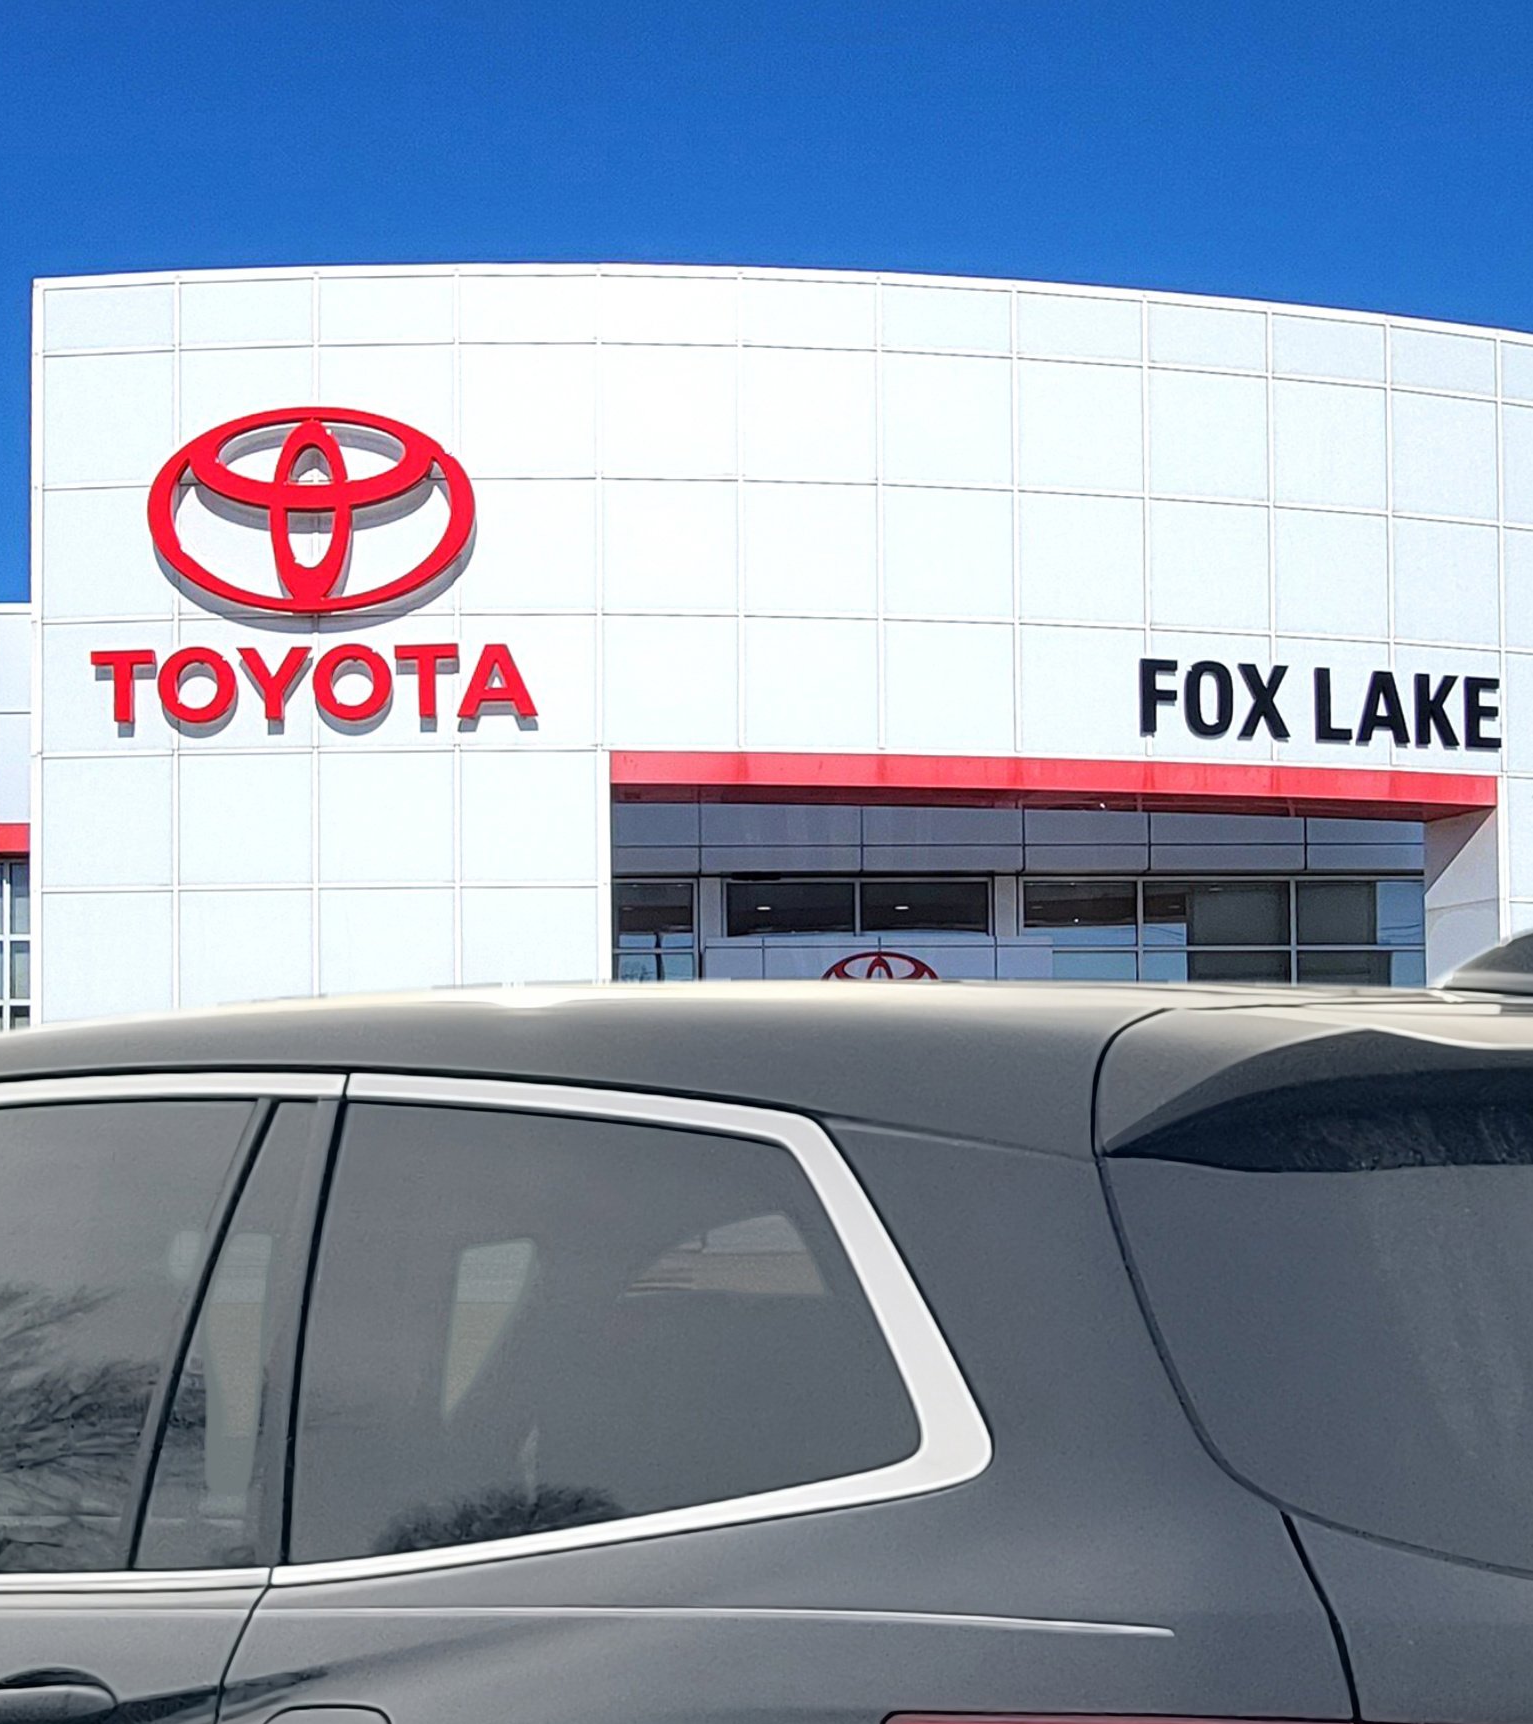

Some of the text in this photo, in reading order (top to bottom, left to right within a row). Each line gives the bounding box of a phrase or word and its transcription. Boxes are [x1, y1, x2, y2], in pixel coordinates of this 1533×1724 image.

[90, 643, 539, 725] TOYOTA
[1138, 657, 1503, 750] FOX LAKE
